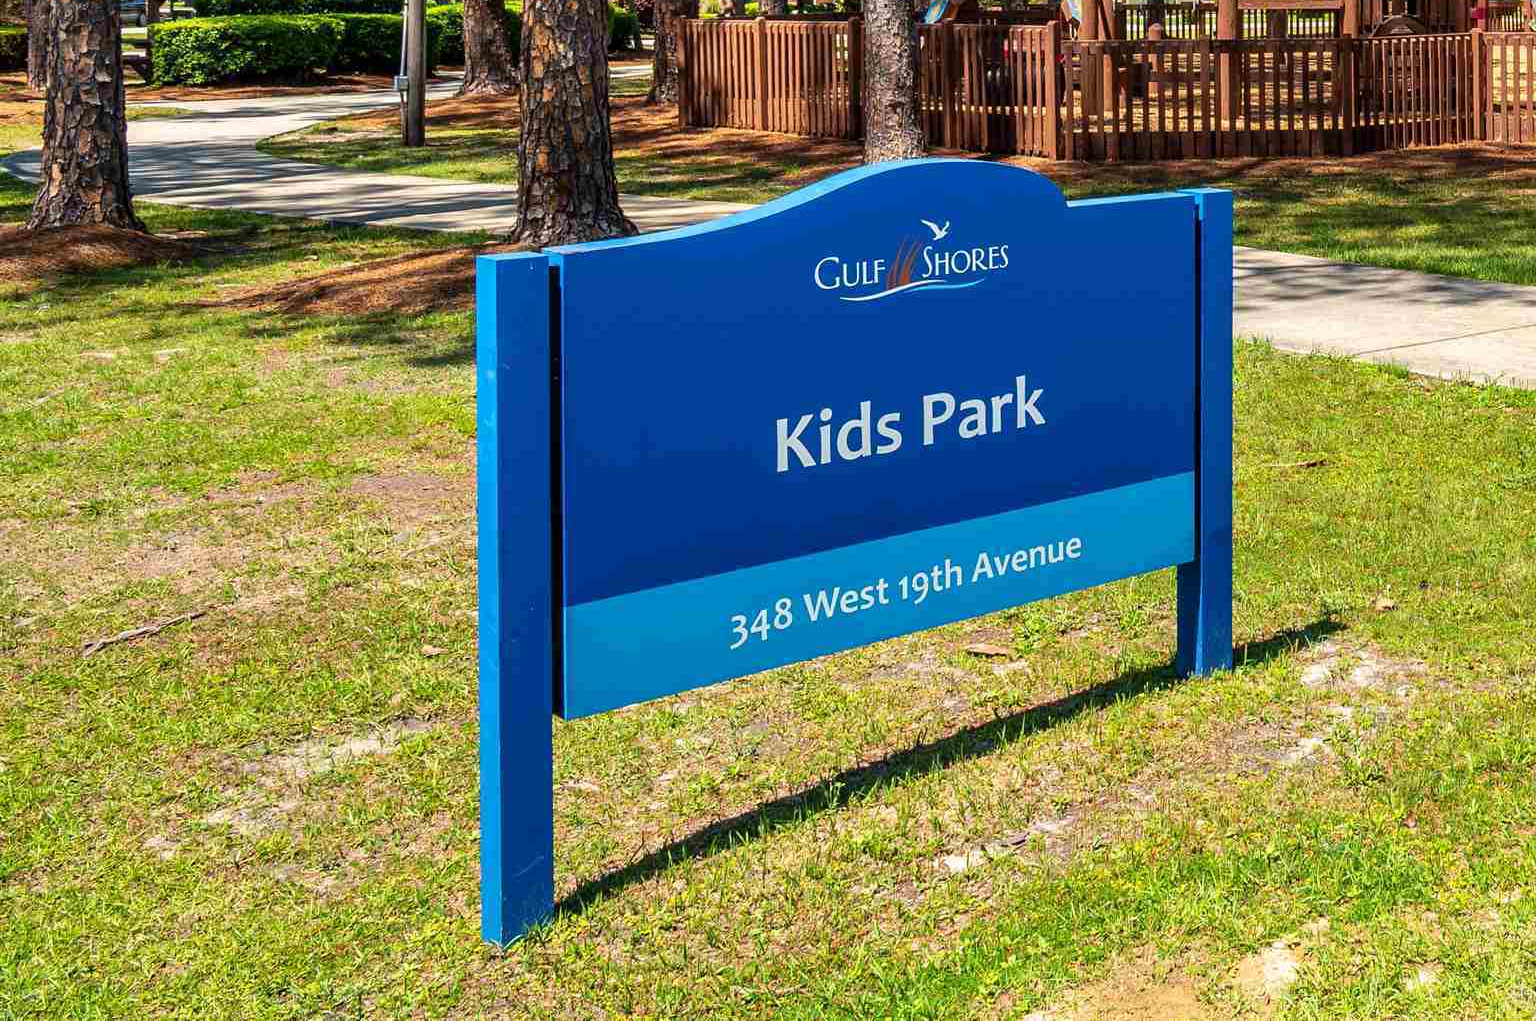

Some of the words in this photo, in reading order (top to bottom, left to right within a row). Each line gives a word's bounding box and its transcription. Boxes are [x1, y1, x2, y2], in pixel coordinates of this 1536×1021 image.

[814, 256, 886, 289] GULF
[922, 244, 1009, 278] SHORES
[776, 400, 903, 473] Kids
[922, 375, 1047, 446] Park
[730, 598, 793, 650] 348
[803, 578, 889, 622] West
[898, 558, 964, 605] 19th
[971, 537, 1083, 583] Avenue
